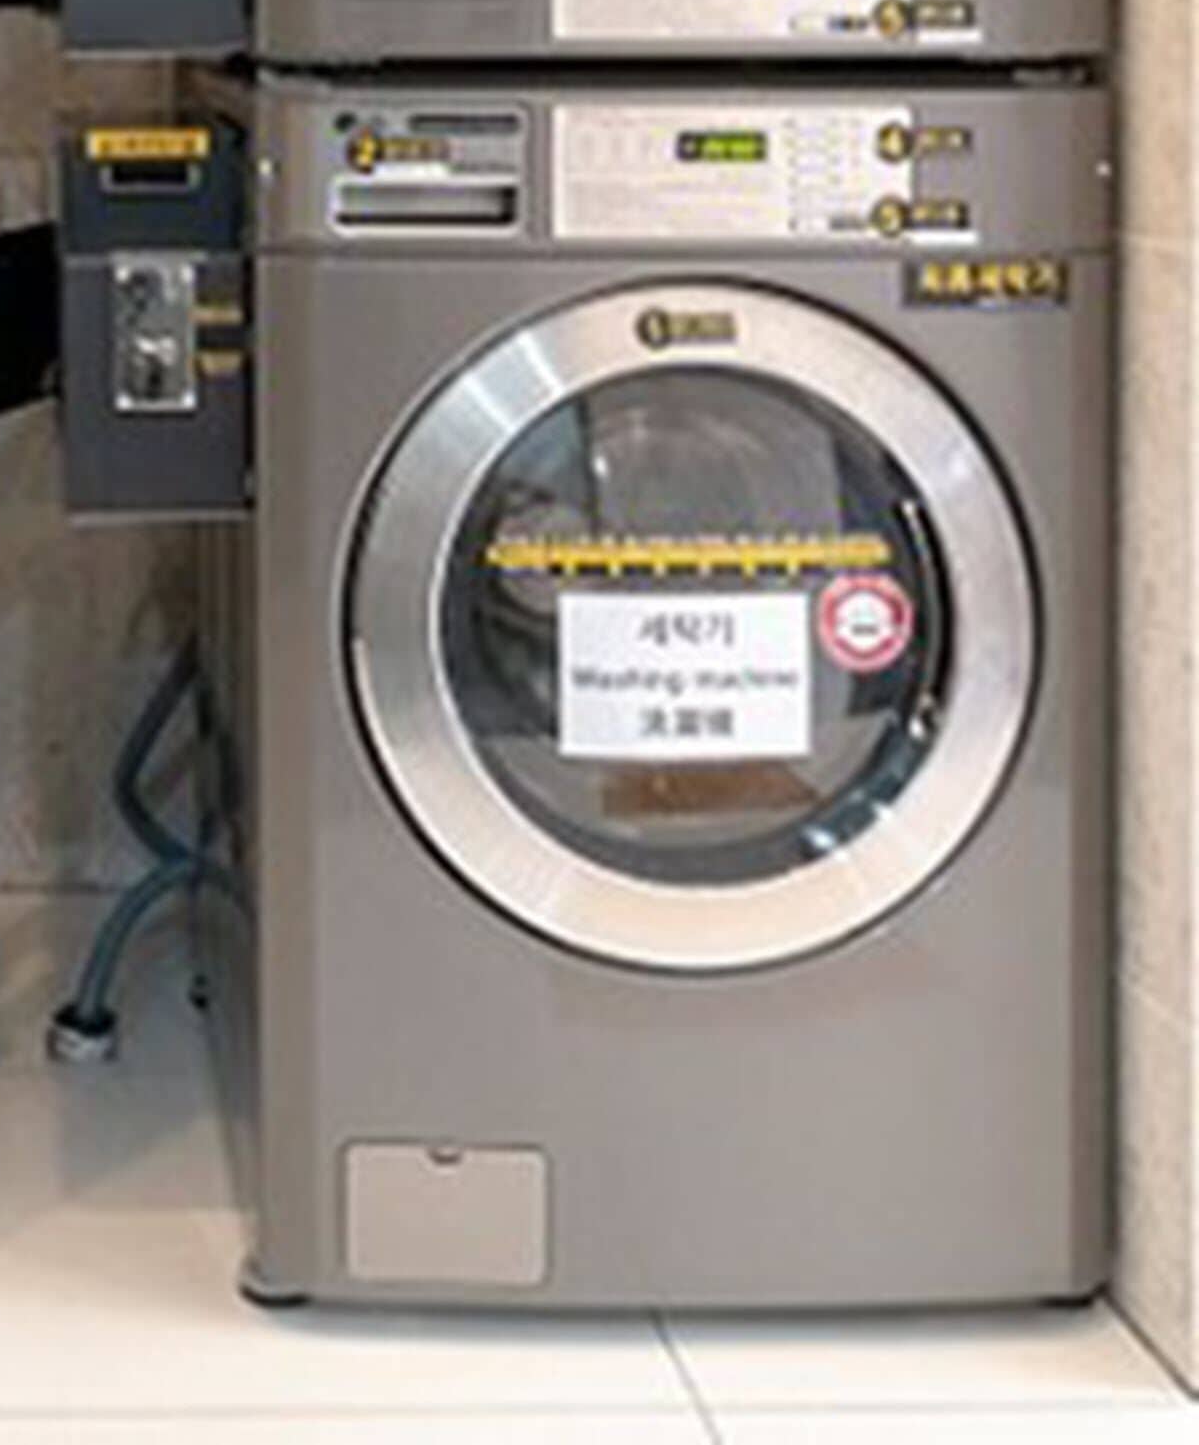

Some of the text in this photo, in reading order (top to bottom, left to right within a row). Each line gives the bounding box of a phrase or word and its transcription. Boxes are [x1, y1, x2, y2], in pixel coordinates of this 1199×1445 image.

[638, 614, 736, 647] 세탁기
[574, 665, 798, 697] Washing machine
